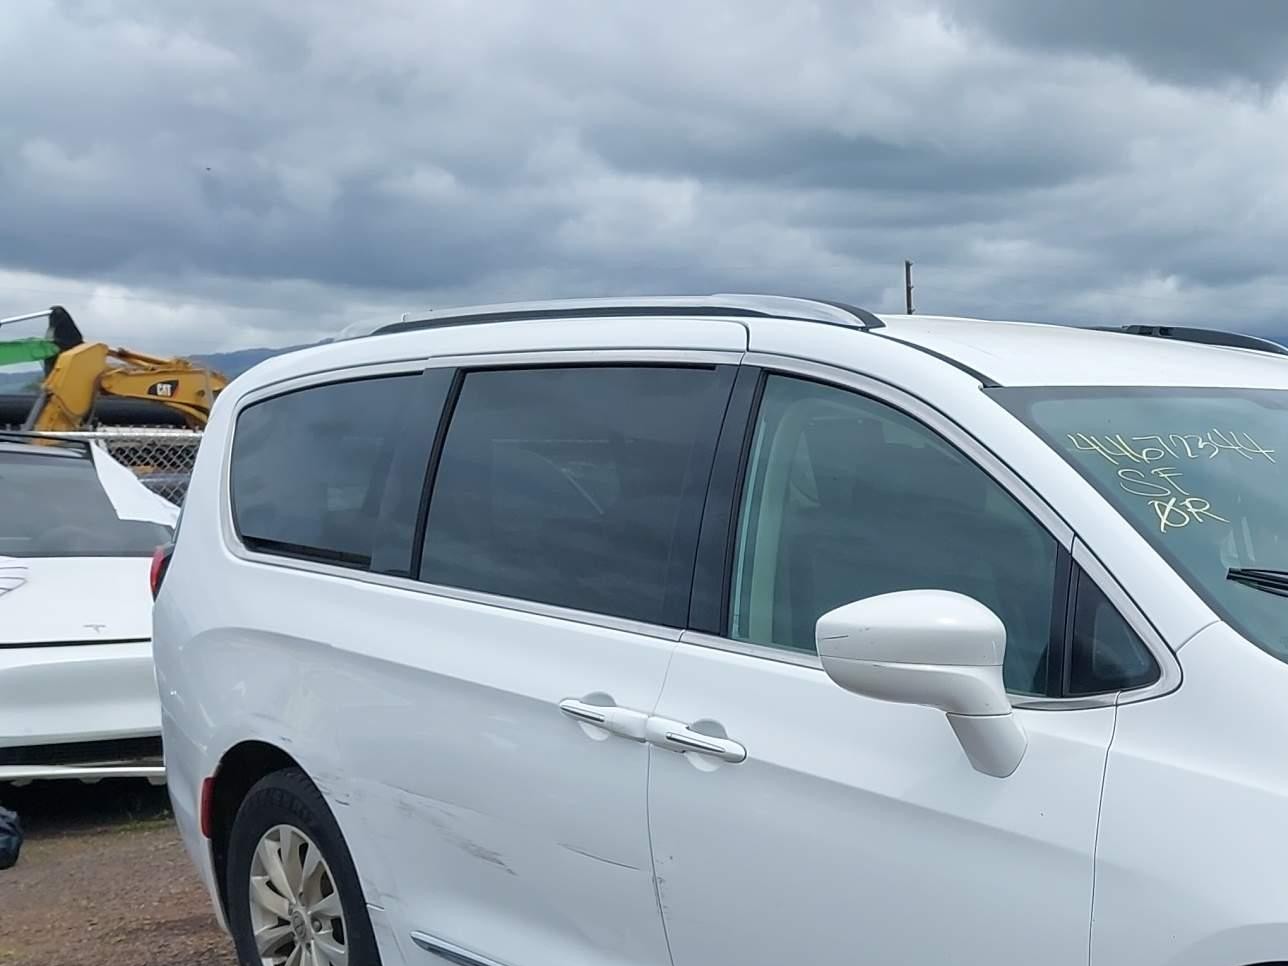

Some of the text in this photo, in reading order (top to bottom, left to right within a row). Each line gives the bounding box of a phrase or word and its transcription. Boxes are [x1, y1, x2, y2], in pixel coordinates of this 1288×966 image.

[156, 382, 172, 397] CAT
[1067, 428, 1276, 465] 44672344
[1117, 467, 1190, 497] SF
